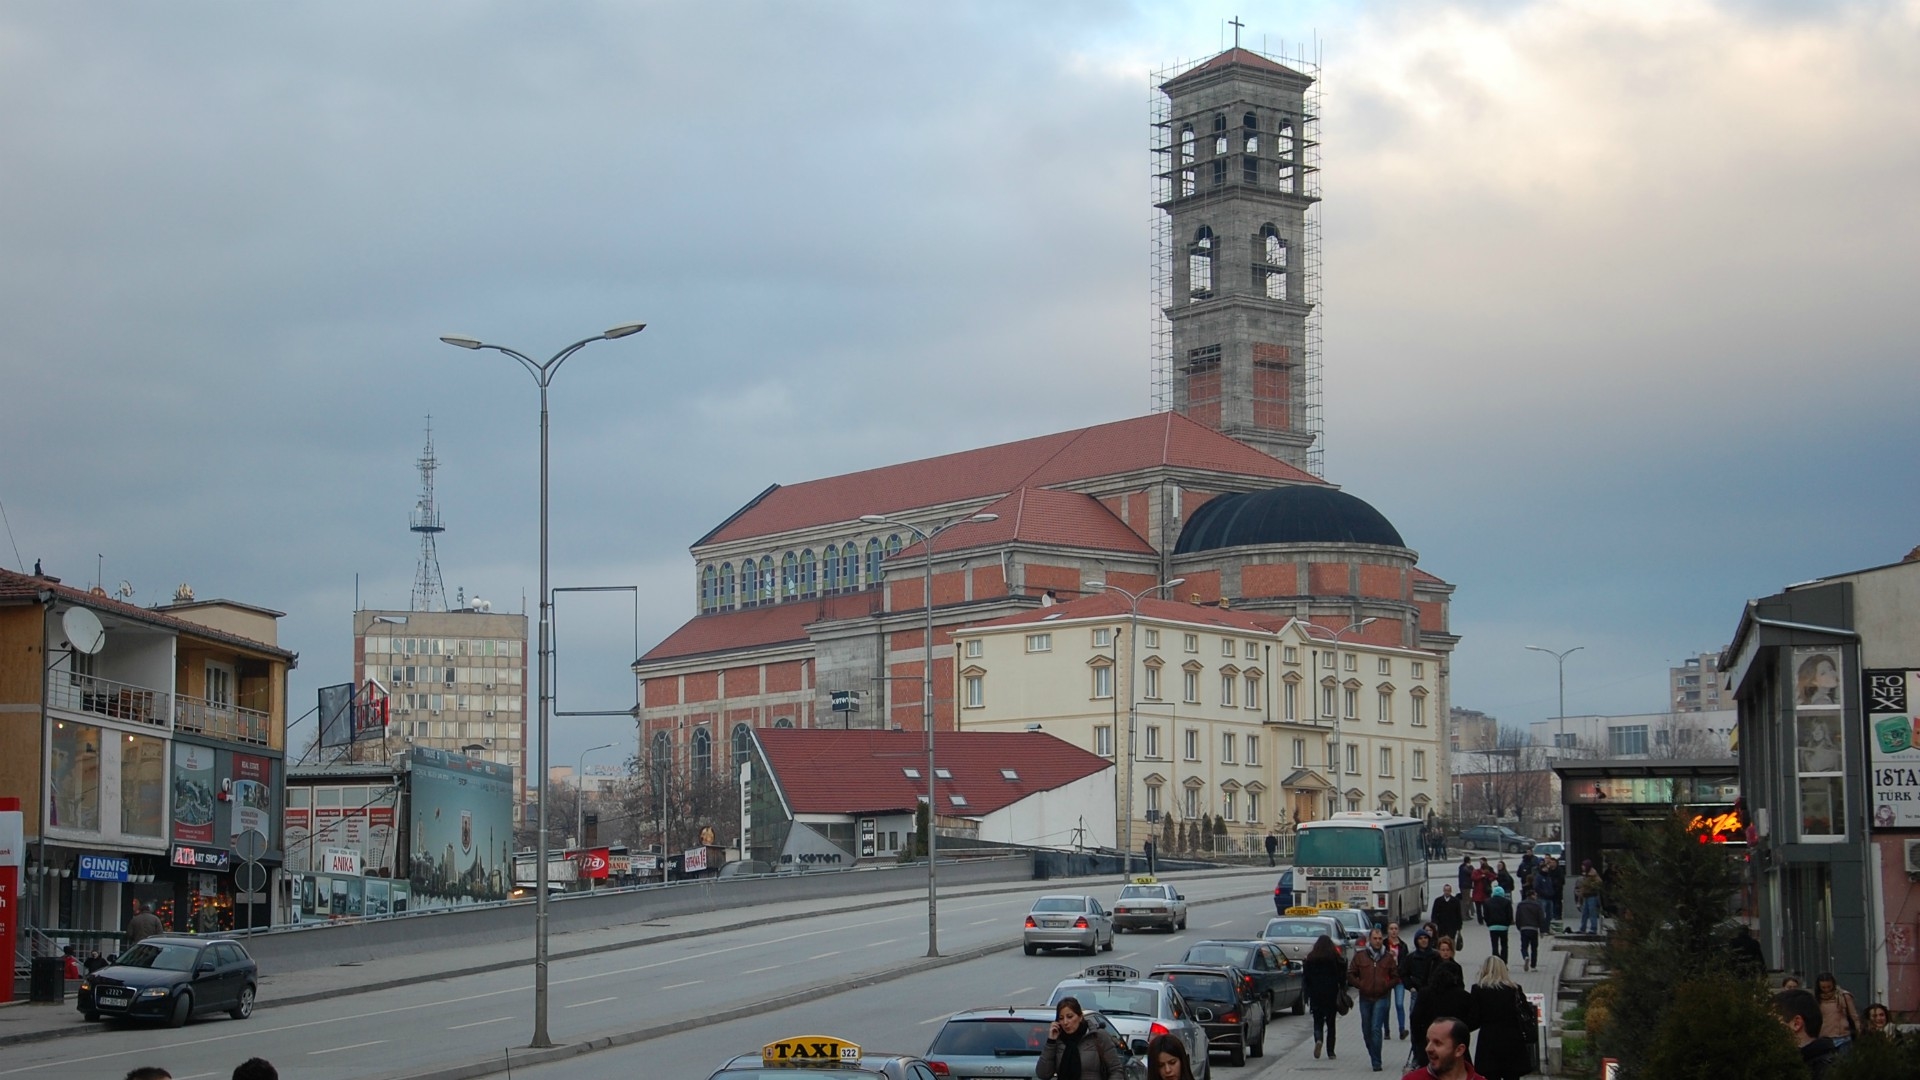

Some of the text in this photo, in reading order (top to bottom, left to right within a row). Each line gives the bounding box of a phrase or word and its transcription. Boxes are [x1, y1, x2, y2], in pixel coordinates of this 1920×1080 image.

[1871, 675, 1904, 687] FO
[1871, 687, 1904, 698] NE
[1875, 768, 1920, 787] ISTA
[82, 857, 128, 872] GINNIS
[333, 855, 353, 872] ANIKA
[90, 870, 118, 879] PIZZERIA
[1313, 868, 1381, 877] KASTRIOTI 2
[1097, 969, 1126, 977] GETI
[775, 1043, 856, 1058] TAXI 322
